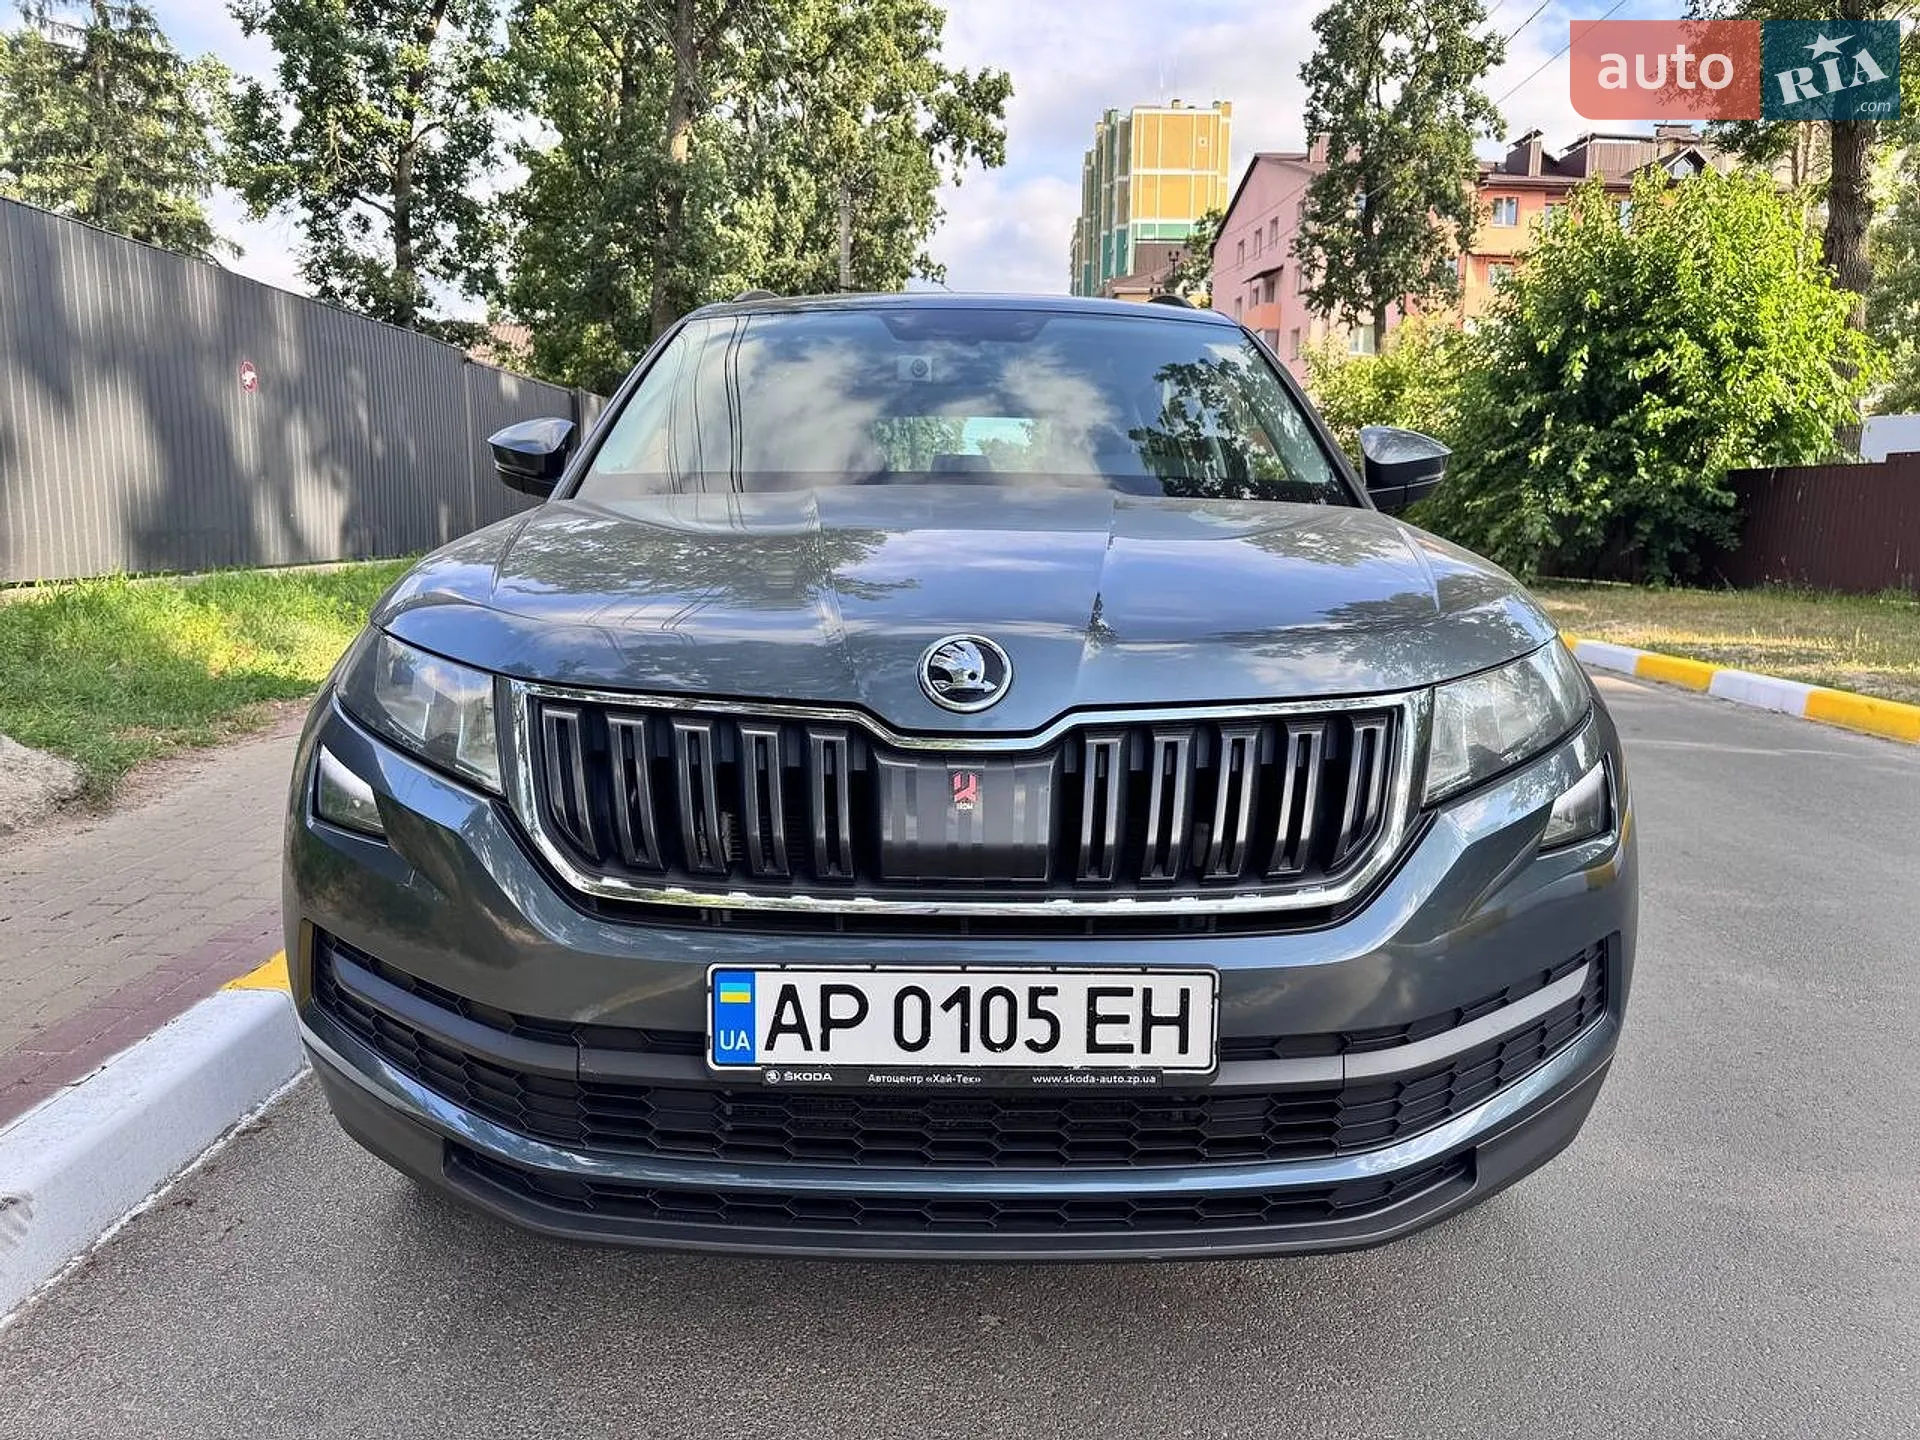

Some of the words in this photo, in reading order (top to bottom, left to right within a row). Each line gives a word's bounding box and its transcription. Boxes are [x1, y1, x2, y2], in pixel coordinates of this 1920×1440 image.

[764, 983, 870, 1052] AP
[893, 985, 1062, 1053] 0105
[1086, 987, 1189, 1055] EH
[719, 1031, 751, 1051] UA
[867, 1074, 923, 1084] Автоцентр
[1032, 1074, 1156, 1085] www.skoda-auto.zp.ua
